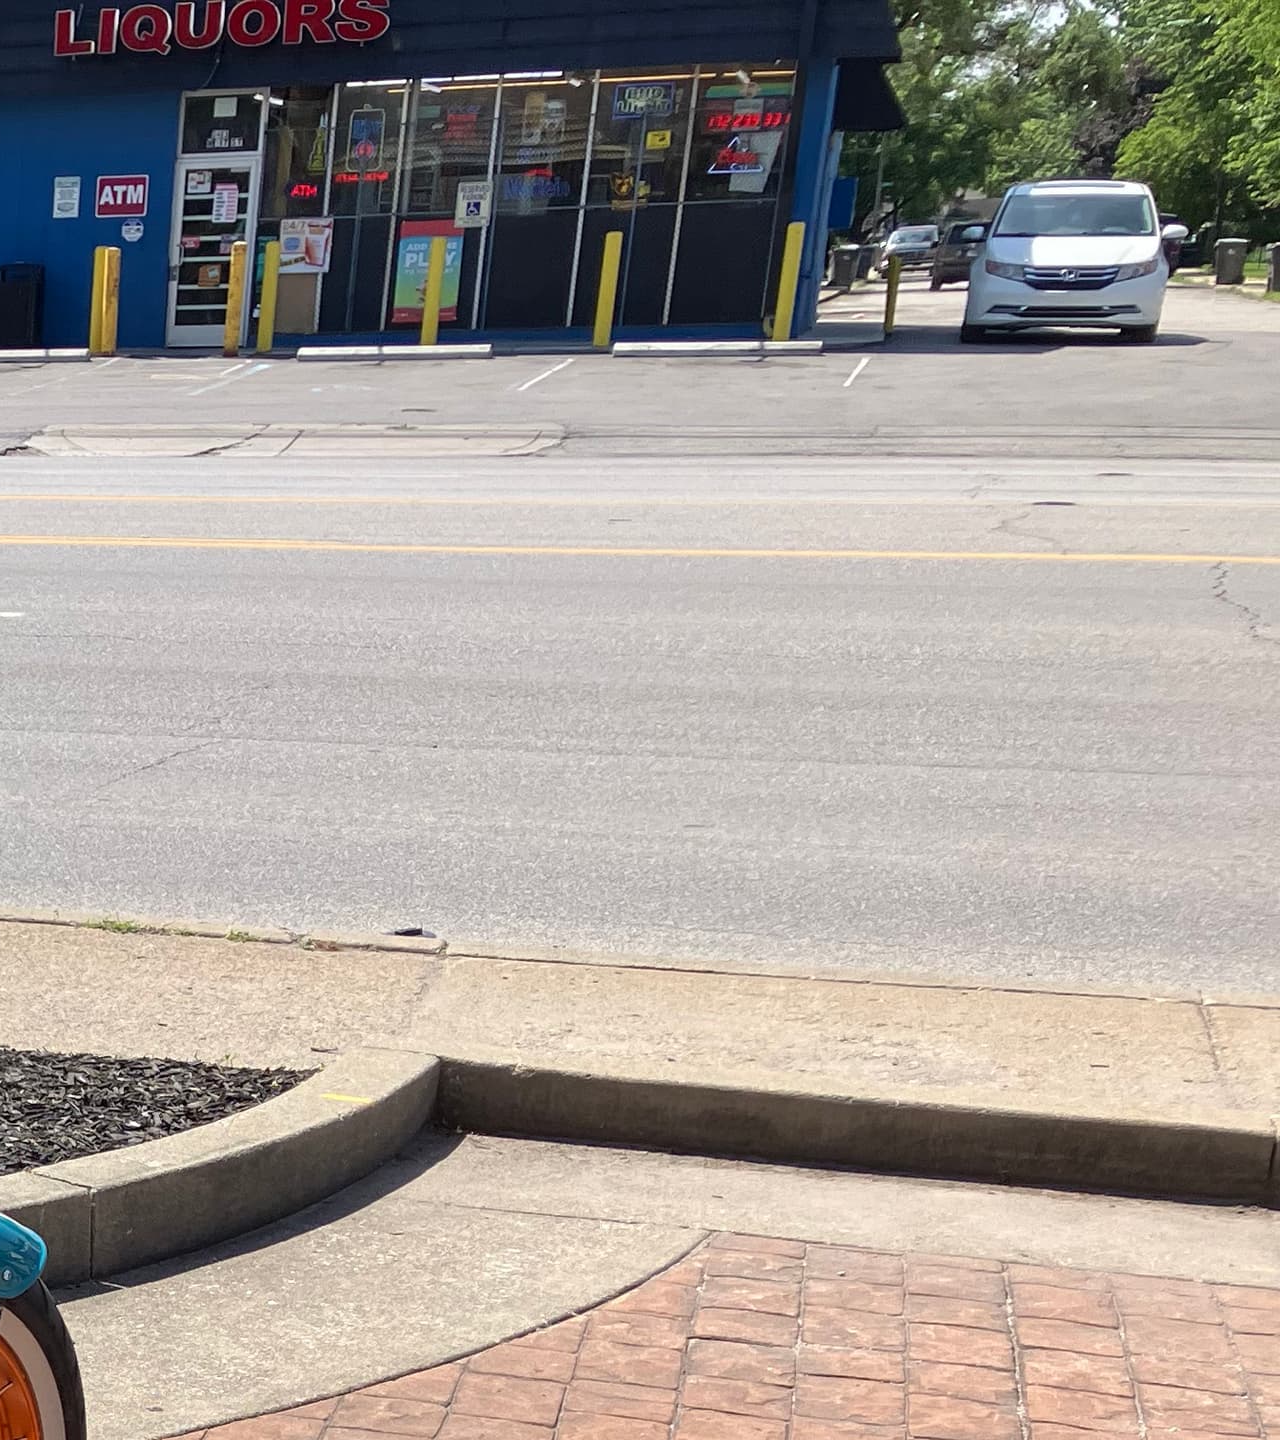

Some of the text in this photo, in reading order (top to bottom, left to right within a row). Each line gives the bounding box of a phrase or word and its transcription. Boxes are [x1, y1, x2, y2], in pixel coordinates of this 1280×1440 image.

[54, 0, 390, 56] LIQUORS
[99, 184, 144, 205] ATM
[290, 184, 317, 197] ATM
[404, 252, 457, 268] PLY
